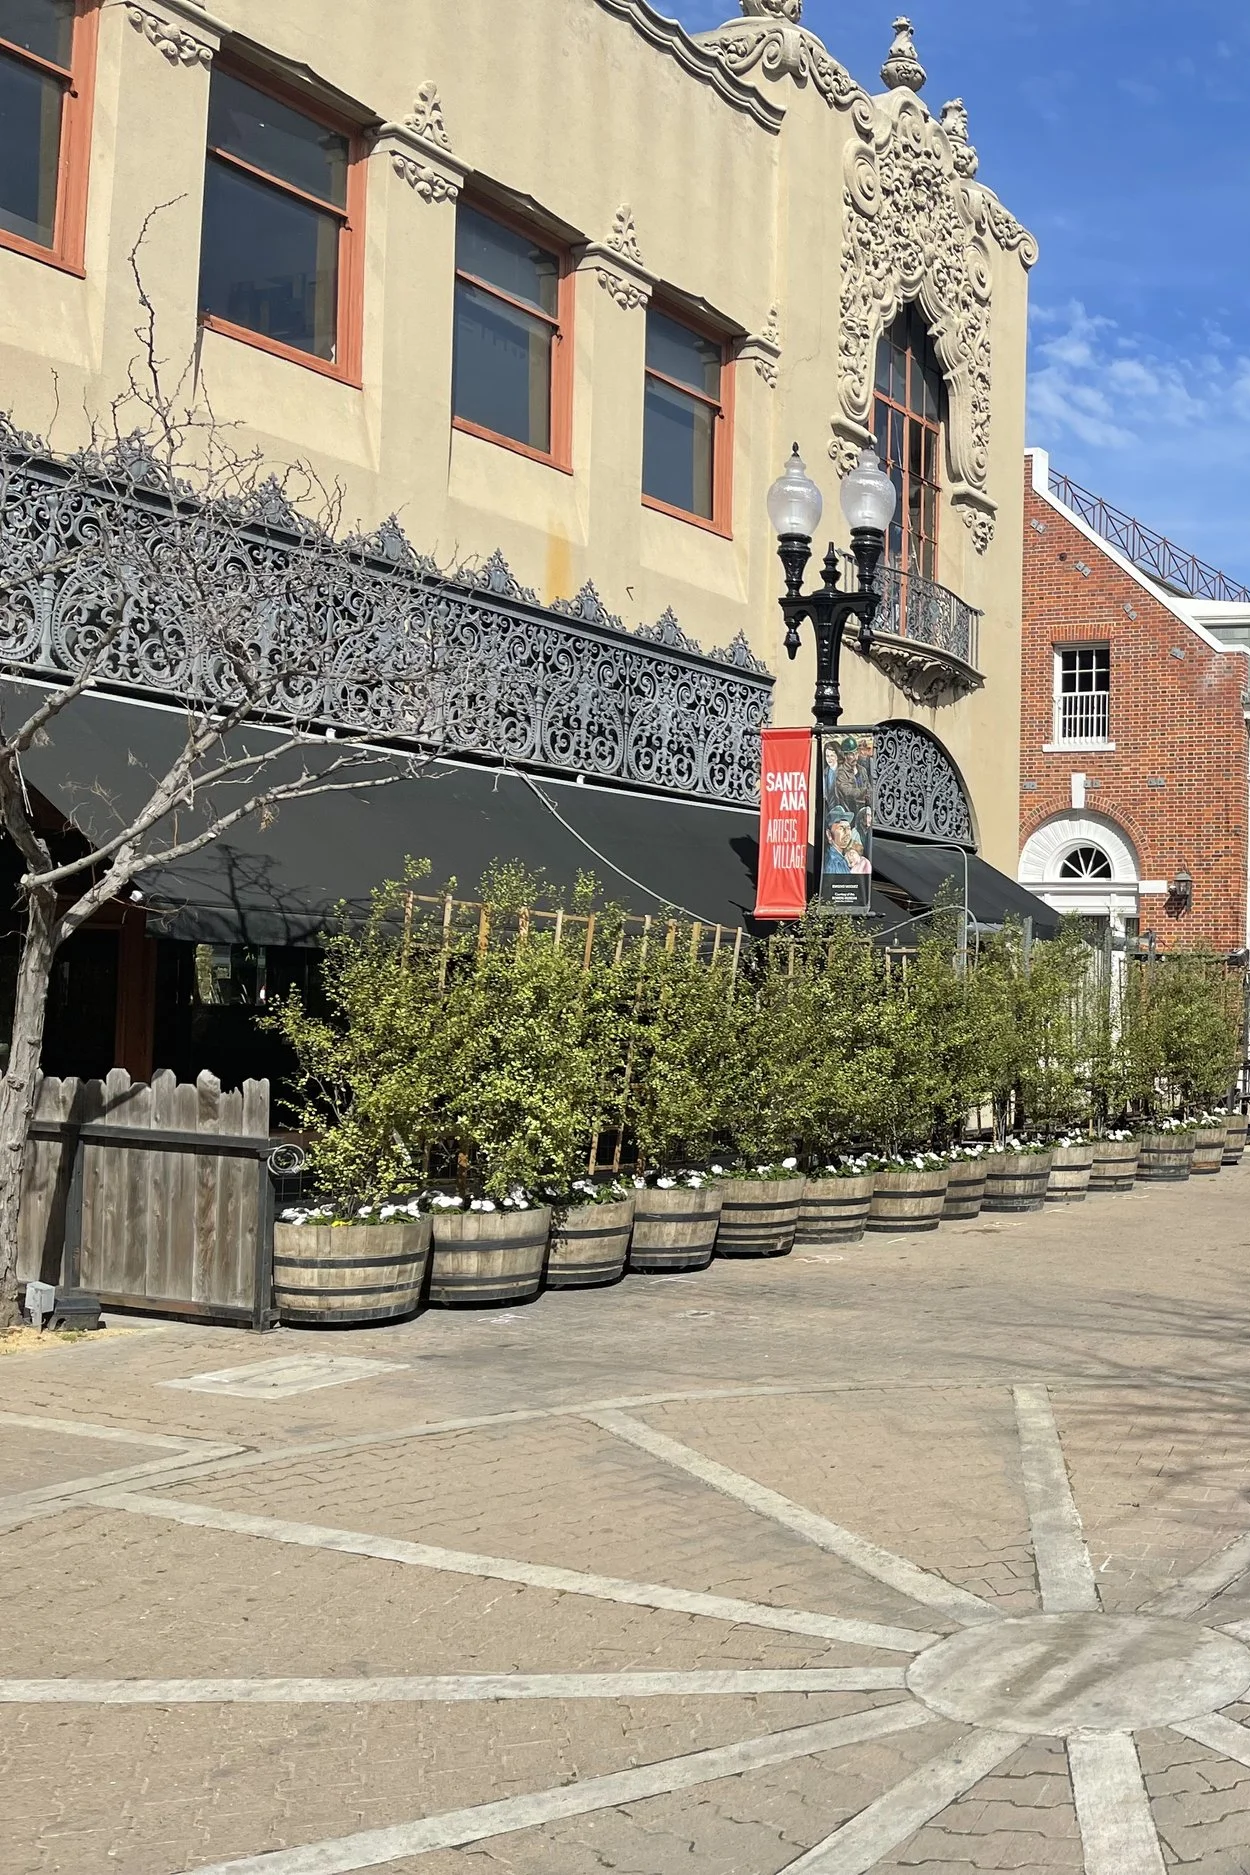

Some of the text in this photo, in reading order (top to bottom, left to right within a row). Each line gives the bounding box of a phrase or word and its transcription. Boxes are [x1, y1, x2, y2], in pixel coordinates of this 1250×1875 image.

[766, 772, 807, 792] SANTA
[780, 791, 806, 811] ANA
[766, 818, 798, 843] ARTISTS
[773, 844, 806, 869] VILLAGE
